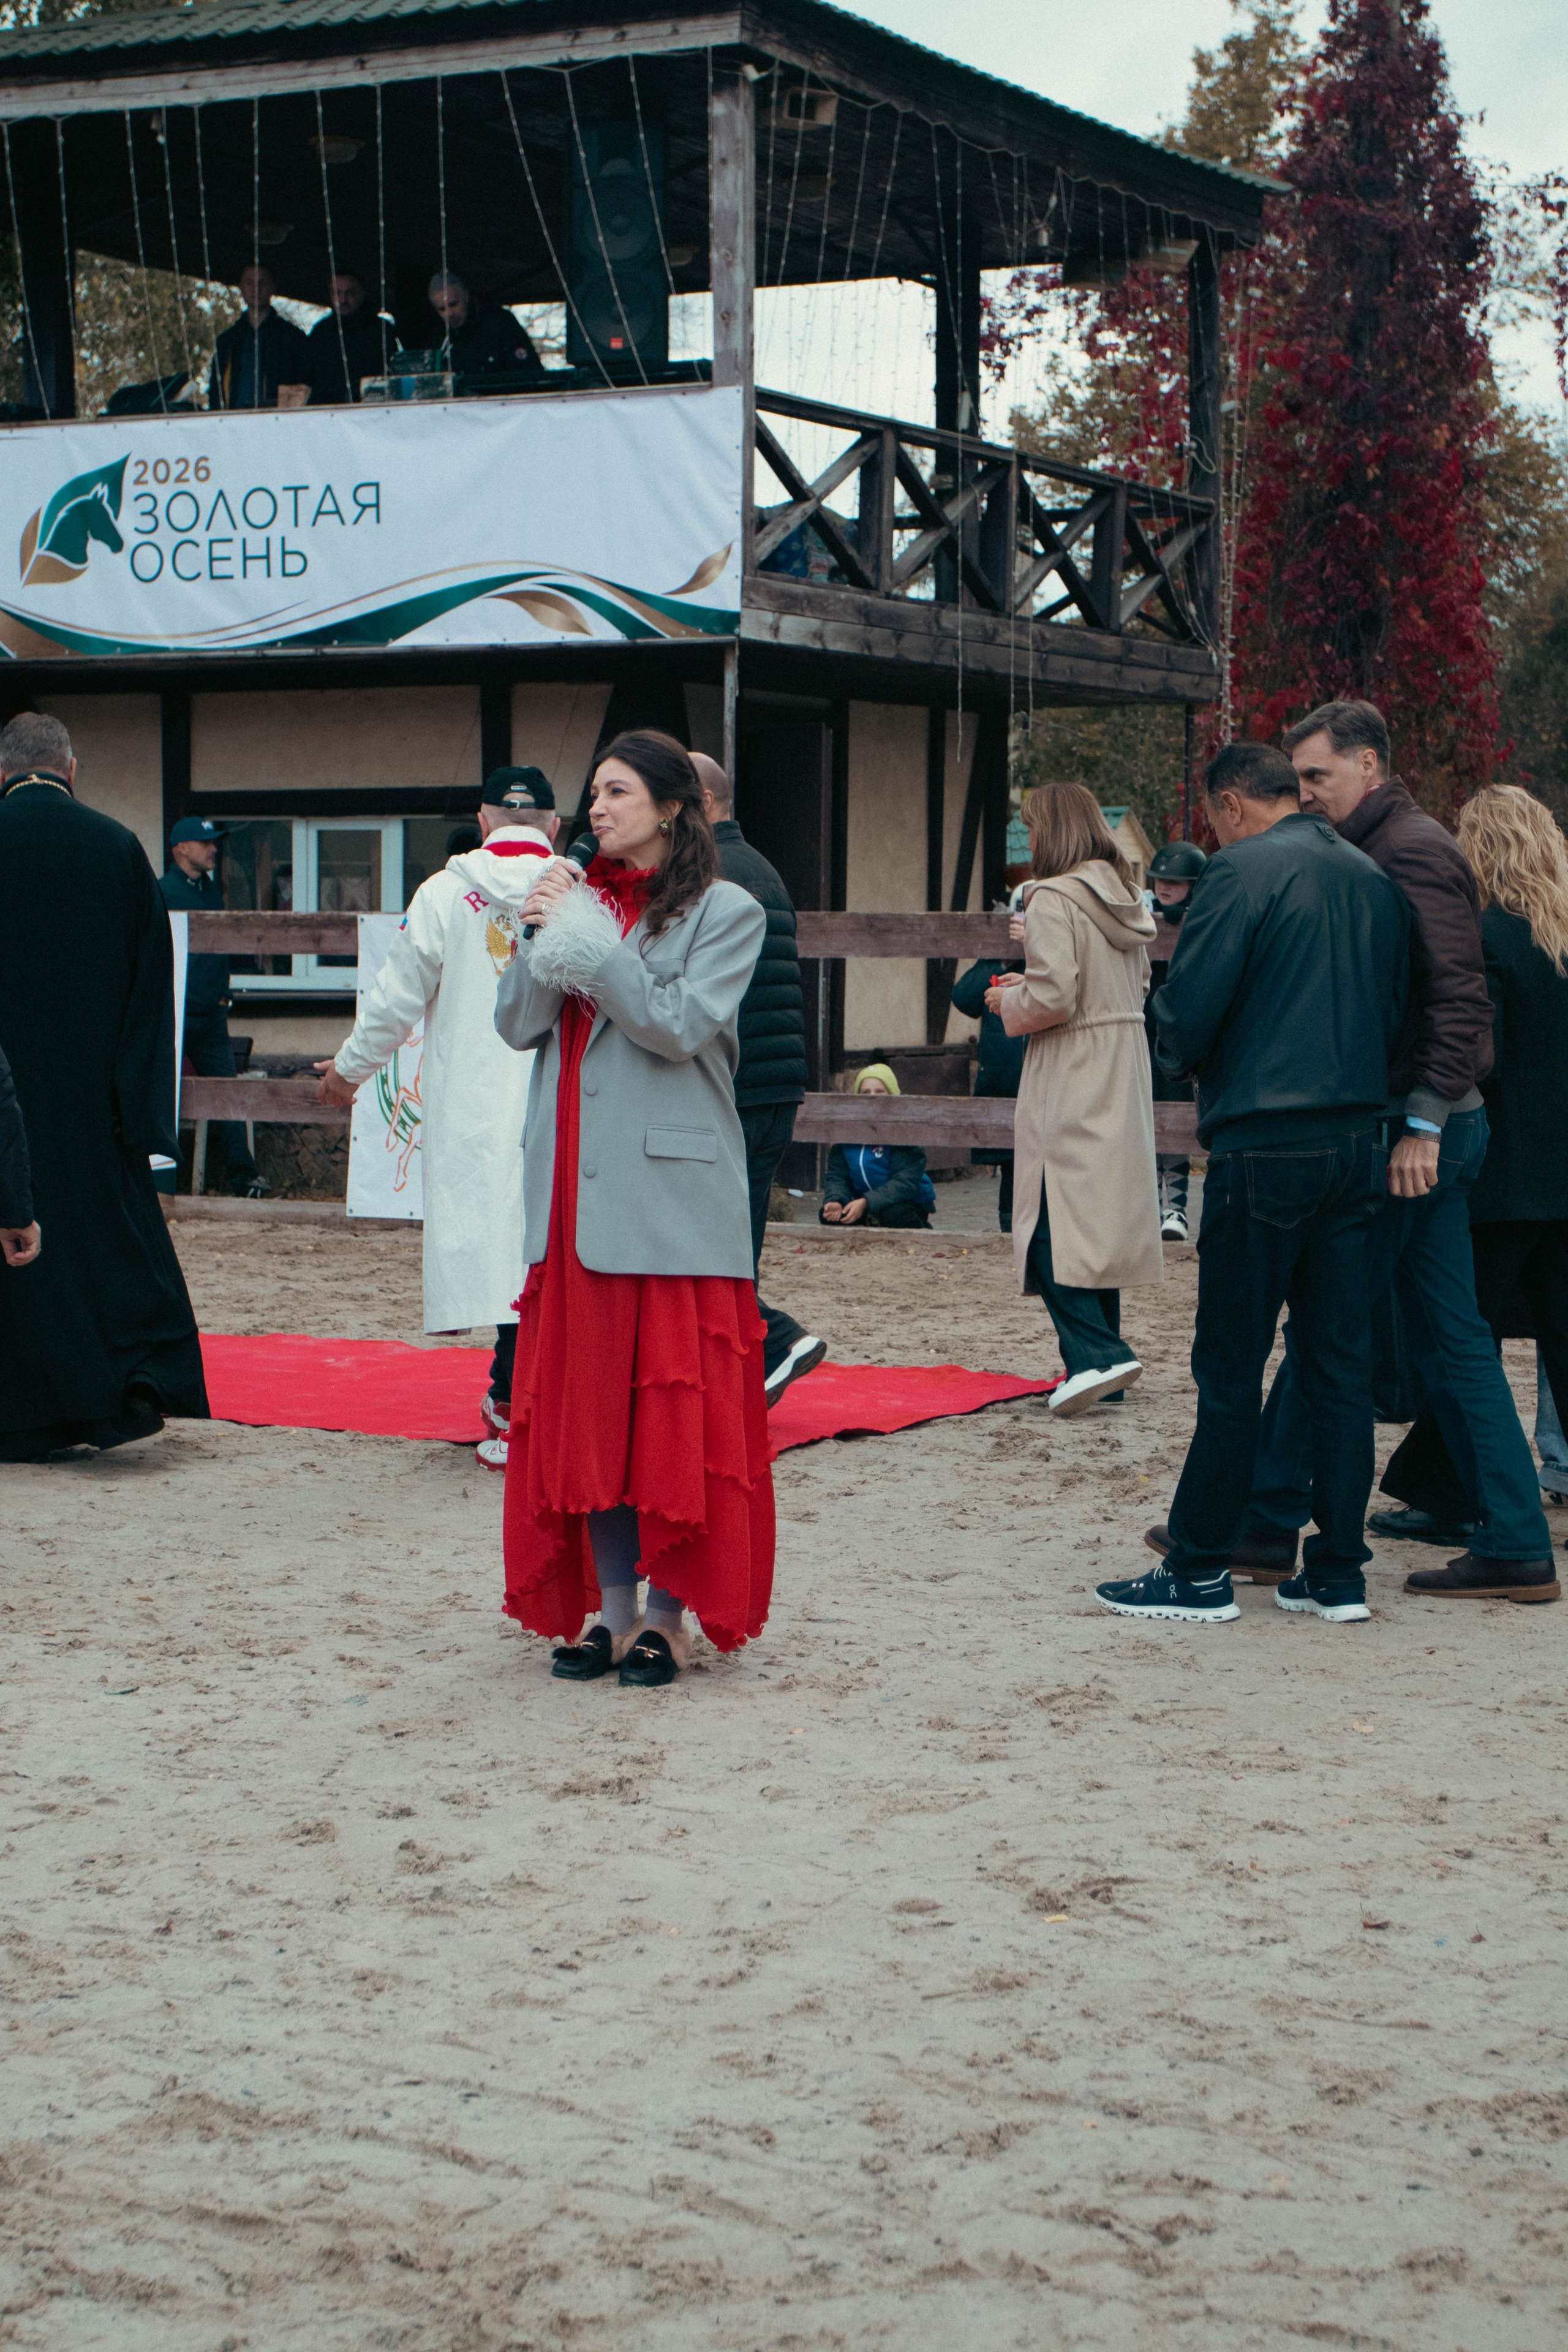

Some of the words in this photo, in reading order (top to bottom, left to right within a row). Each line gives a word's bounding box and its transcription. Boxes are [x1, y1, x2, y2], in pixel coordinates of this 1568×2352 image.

[134, 456, 211, 485] 2026
[134, 482, 380, 534] ЗОЛОТАЯ
[130, 537, 307, 582] ОСЕНЬ
